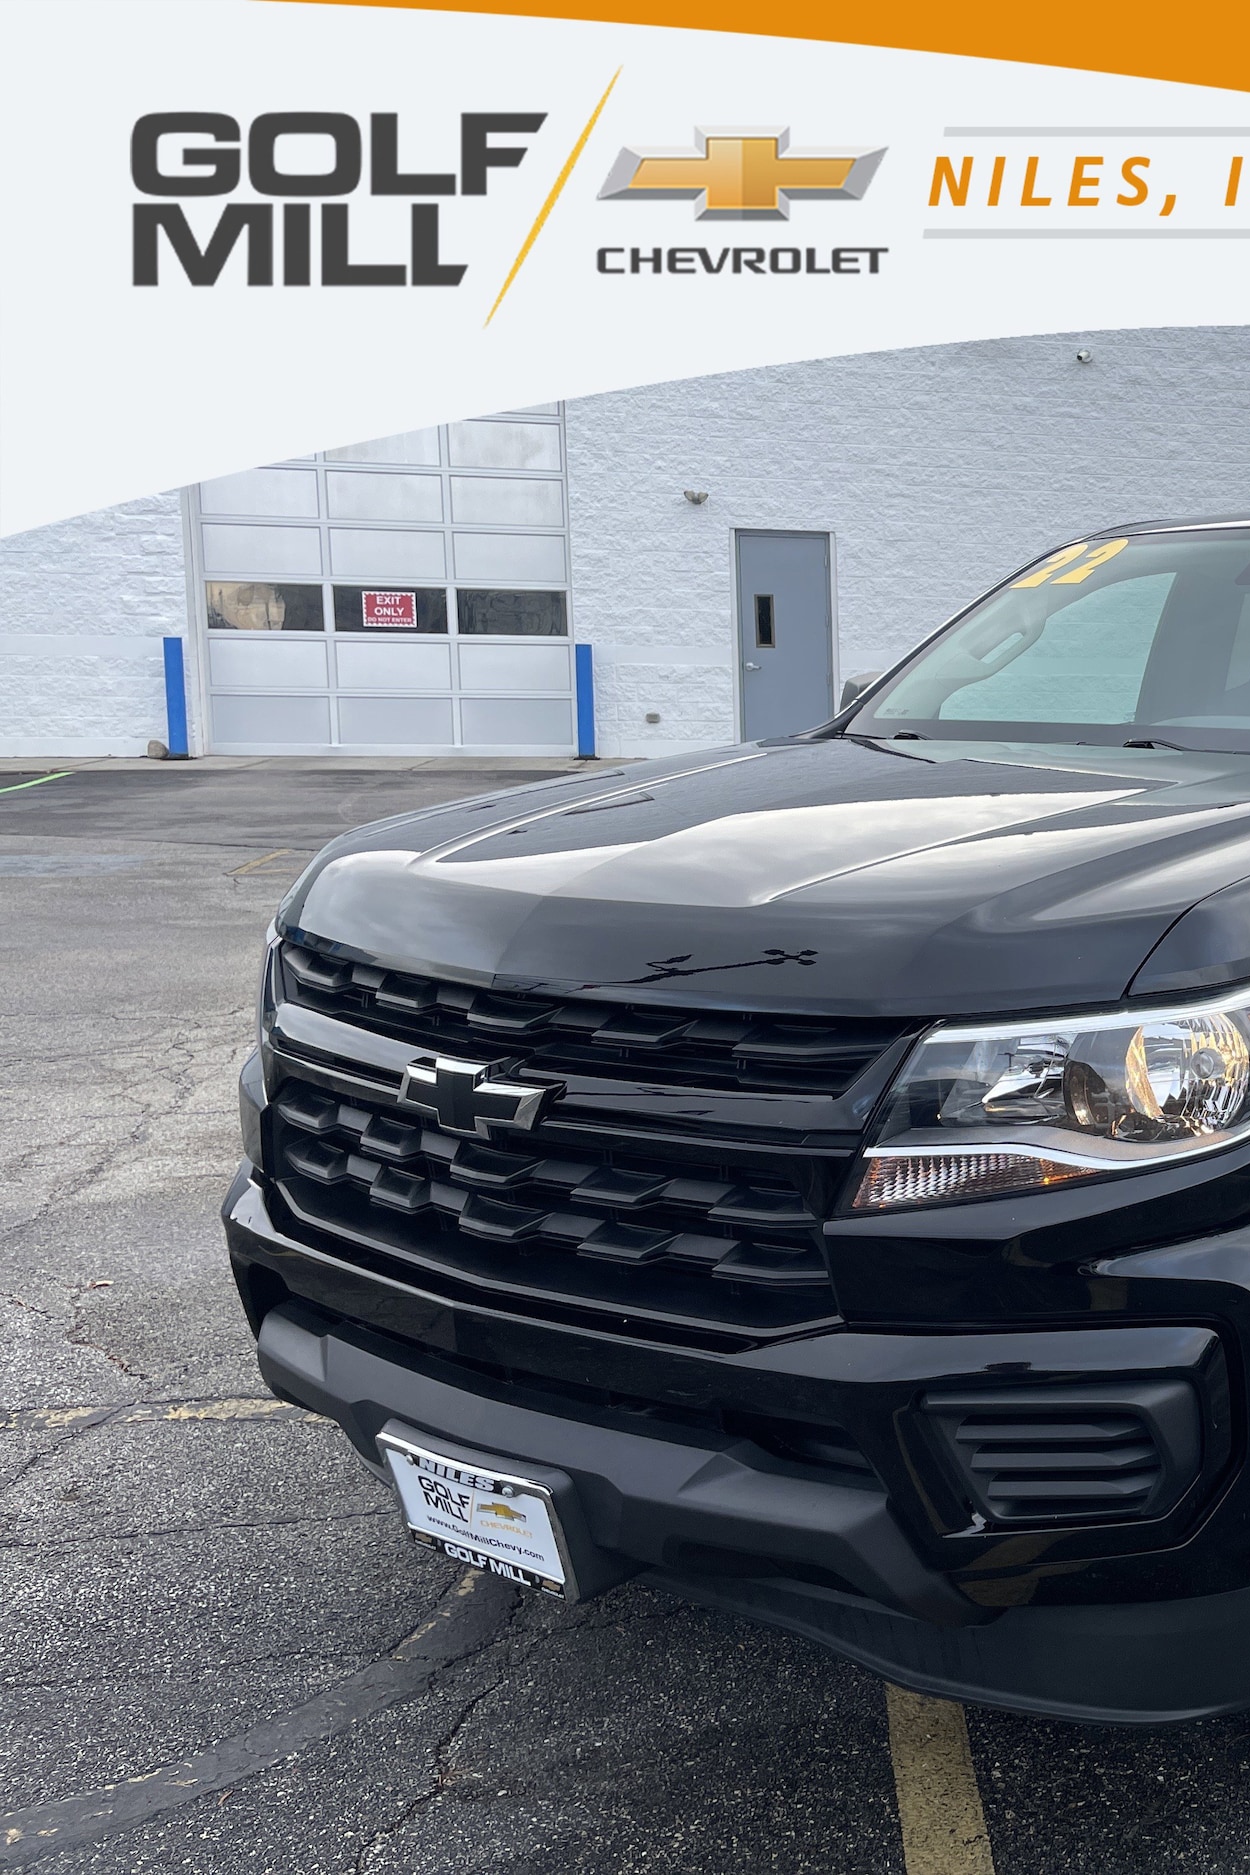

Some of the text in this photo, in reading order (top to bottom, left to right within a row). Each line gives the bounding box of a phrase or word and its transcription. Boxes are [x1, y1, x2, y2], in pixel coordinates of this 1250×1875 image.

[1010, 538, 1129, 589] 22
[374, 607, 404, 616] ONLY
[376, 596, 401, 605] EXIT
[417, 1475, 470, 1509] GOLF
[418, 1458, 495, 1492] NILES
[424, 1492, 469, 1523] MILL
[427, 1515, 545, 1562] www.GolfMillChevy.com
[479, 1519, 534, 1538] CHEVROLET
[444, 1543, 487, 1569] GOLF
[490, 1561, 532, 1586] MILL
